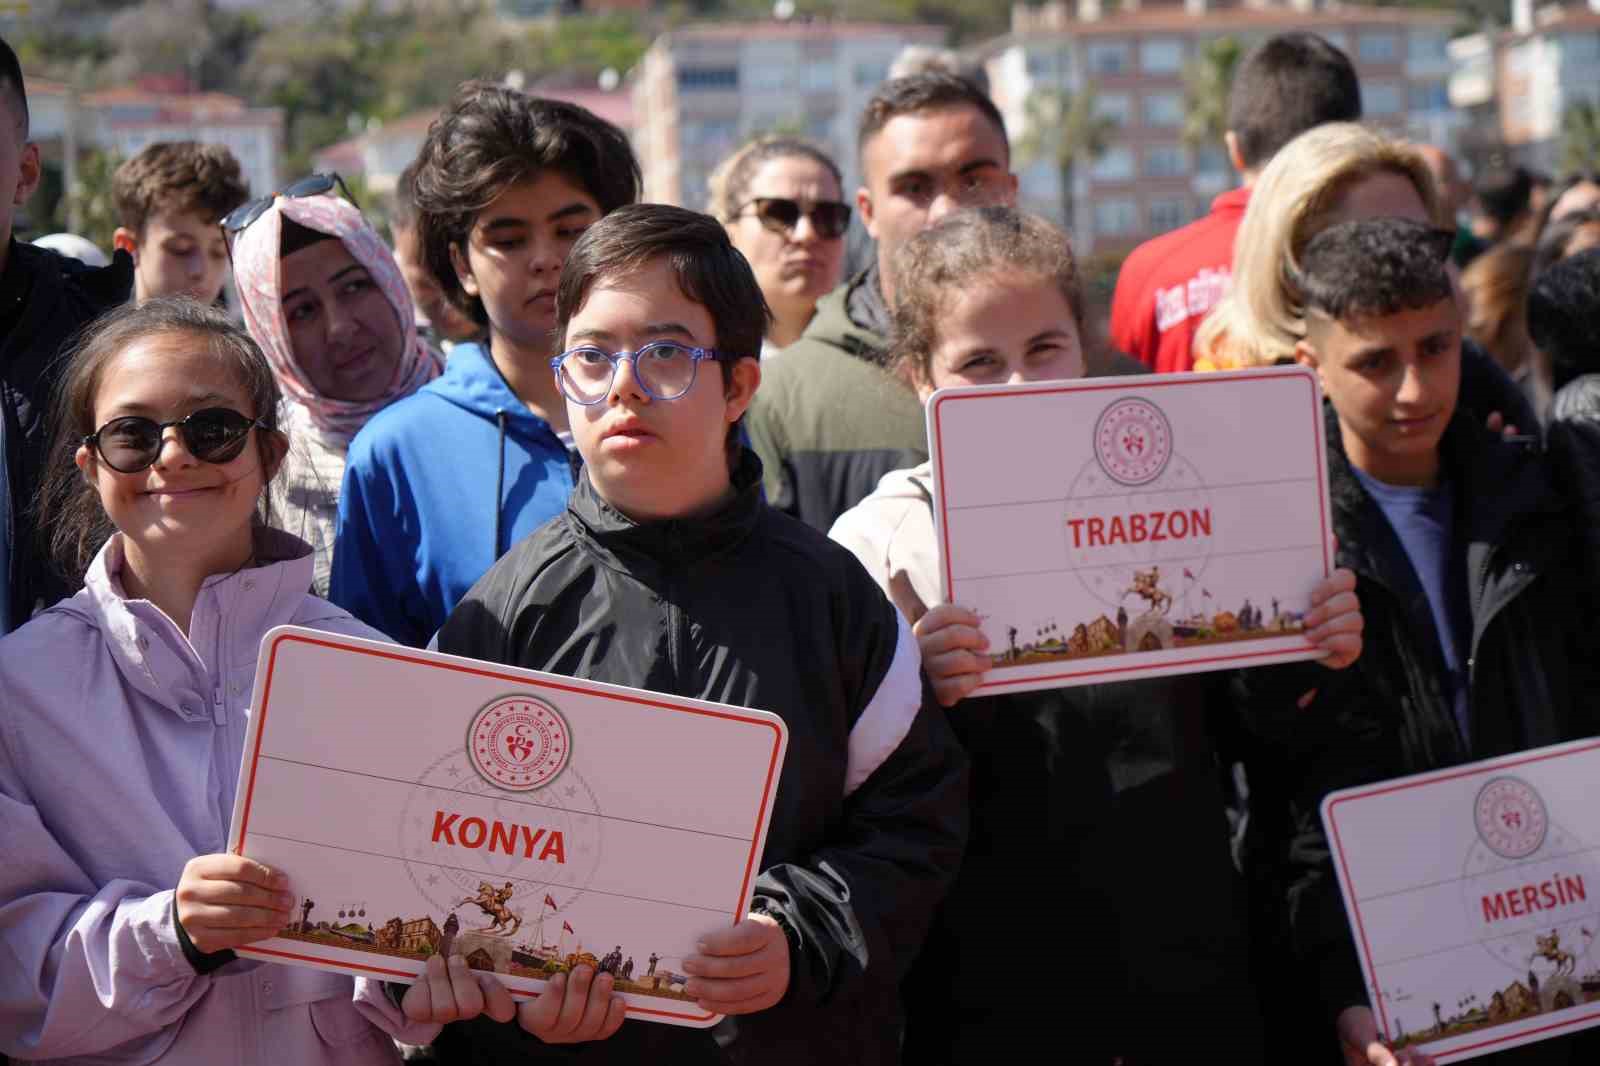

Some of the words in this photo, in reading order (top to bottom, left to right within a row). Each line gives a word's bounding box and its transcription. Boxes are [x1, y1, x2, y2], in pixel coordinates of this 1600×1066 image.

[1067, 508, 1212, 547] TRABZON
[431, 810, 565, 864] KONYA
[1481, 873, 1586, 923] MERSİN
